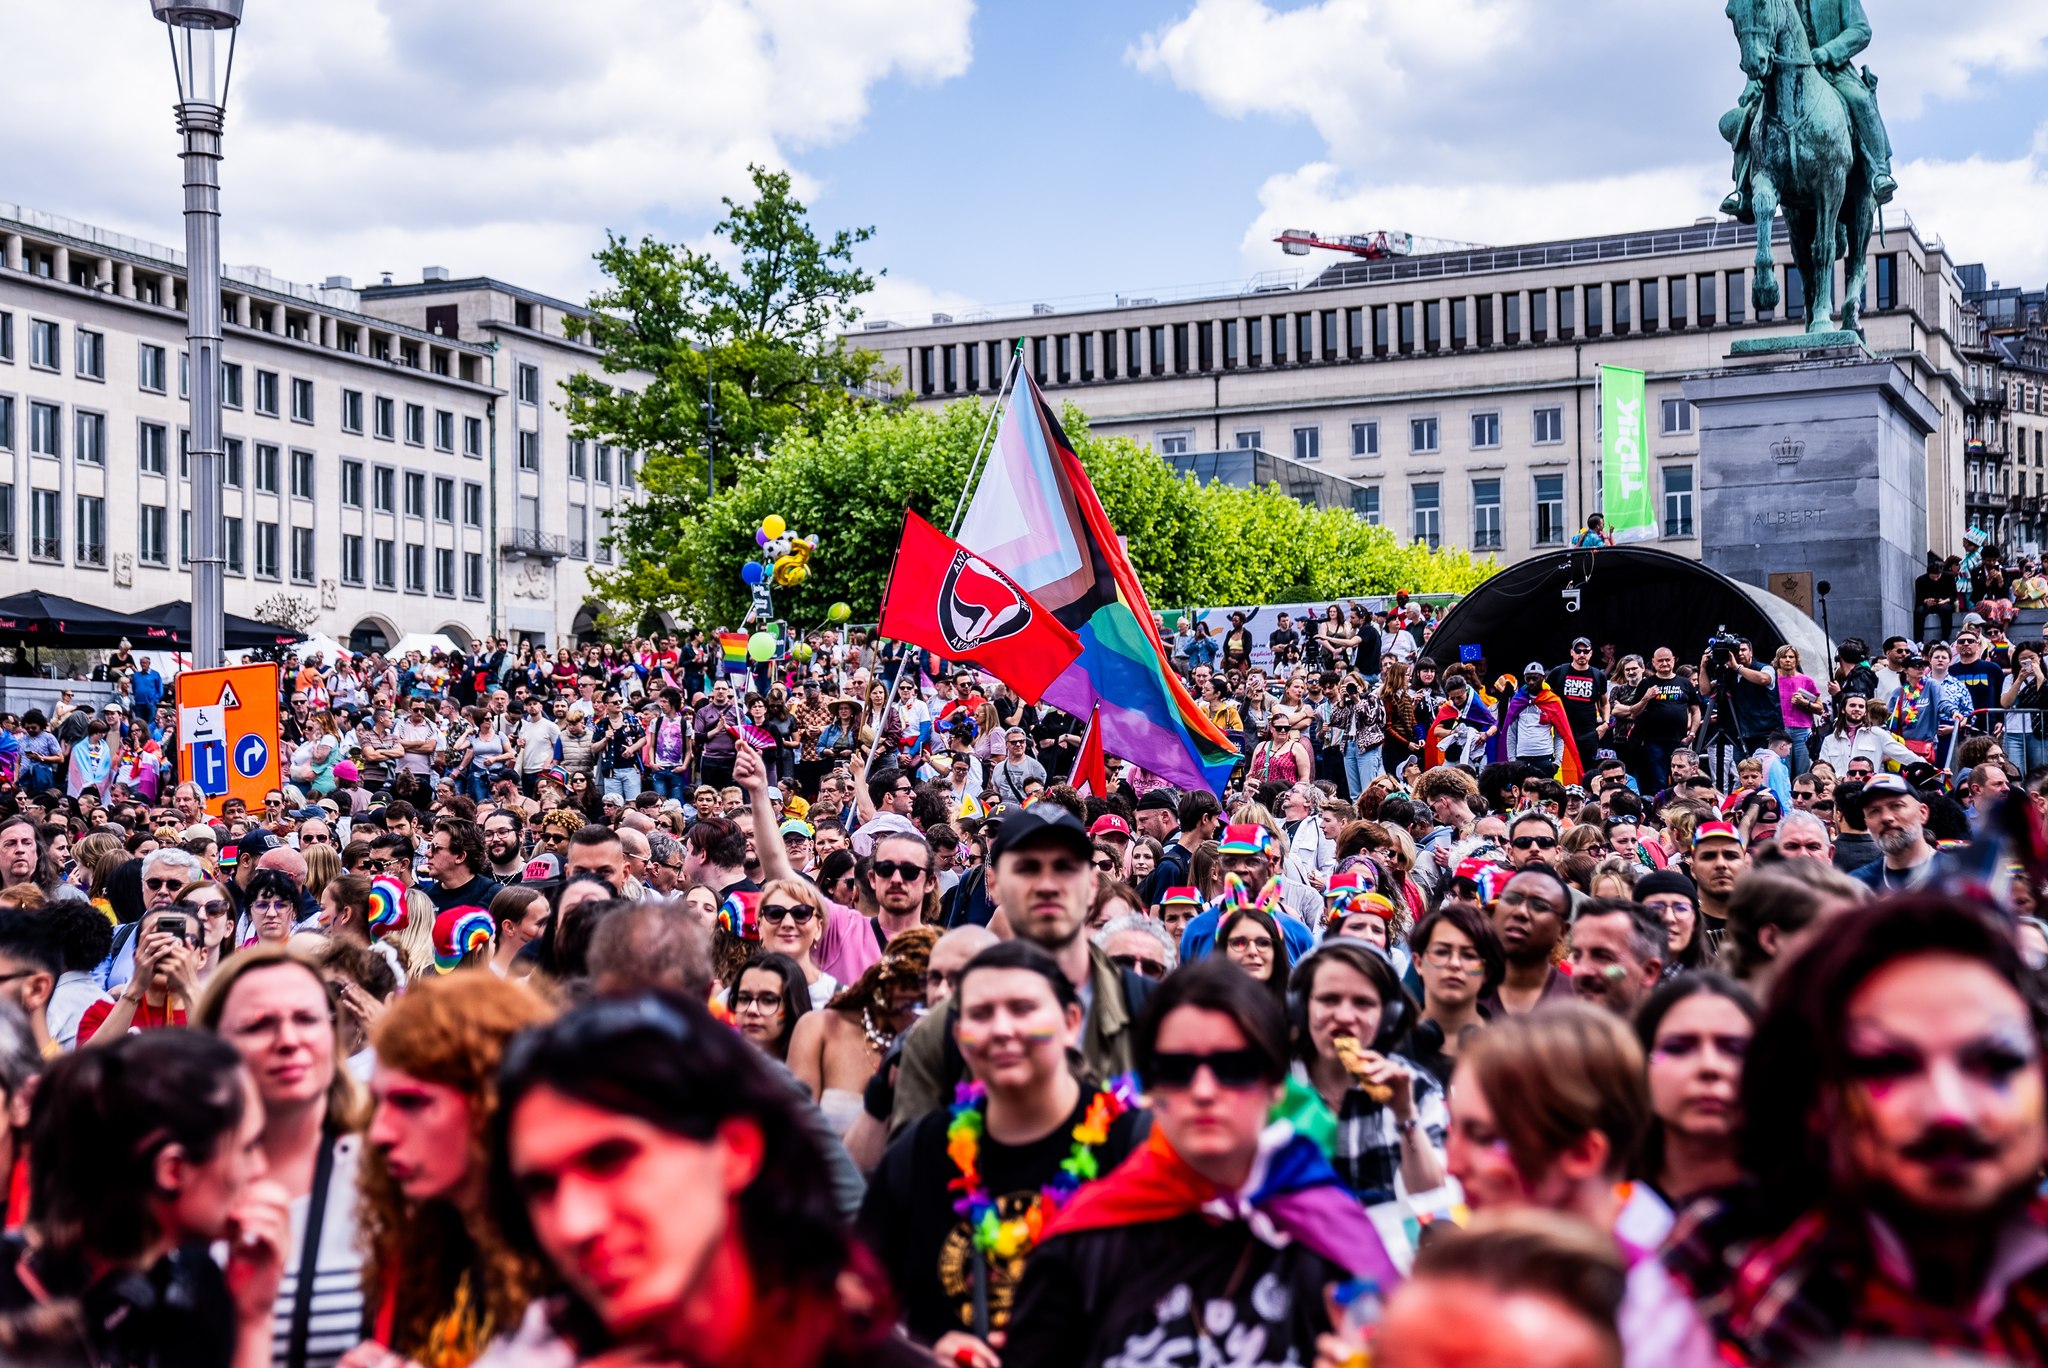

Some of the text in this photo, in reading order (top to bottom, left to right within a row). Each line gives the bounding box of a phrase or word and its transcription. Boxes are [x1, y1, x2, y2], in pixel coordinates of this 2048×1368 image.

[1753, 508, 1826, 526] ALBERT
[1564, 679, 1593, 690] SNKR
[1563, 686, 1593, 698] HEAD
[996, 804, 1006, 815] P
[526, 869, 546, 878] YEAH
